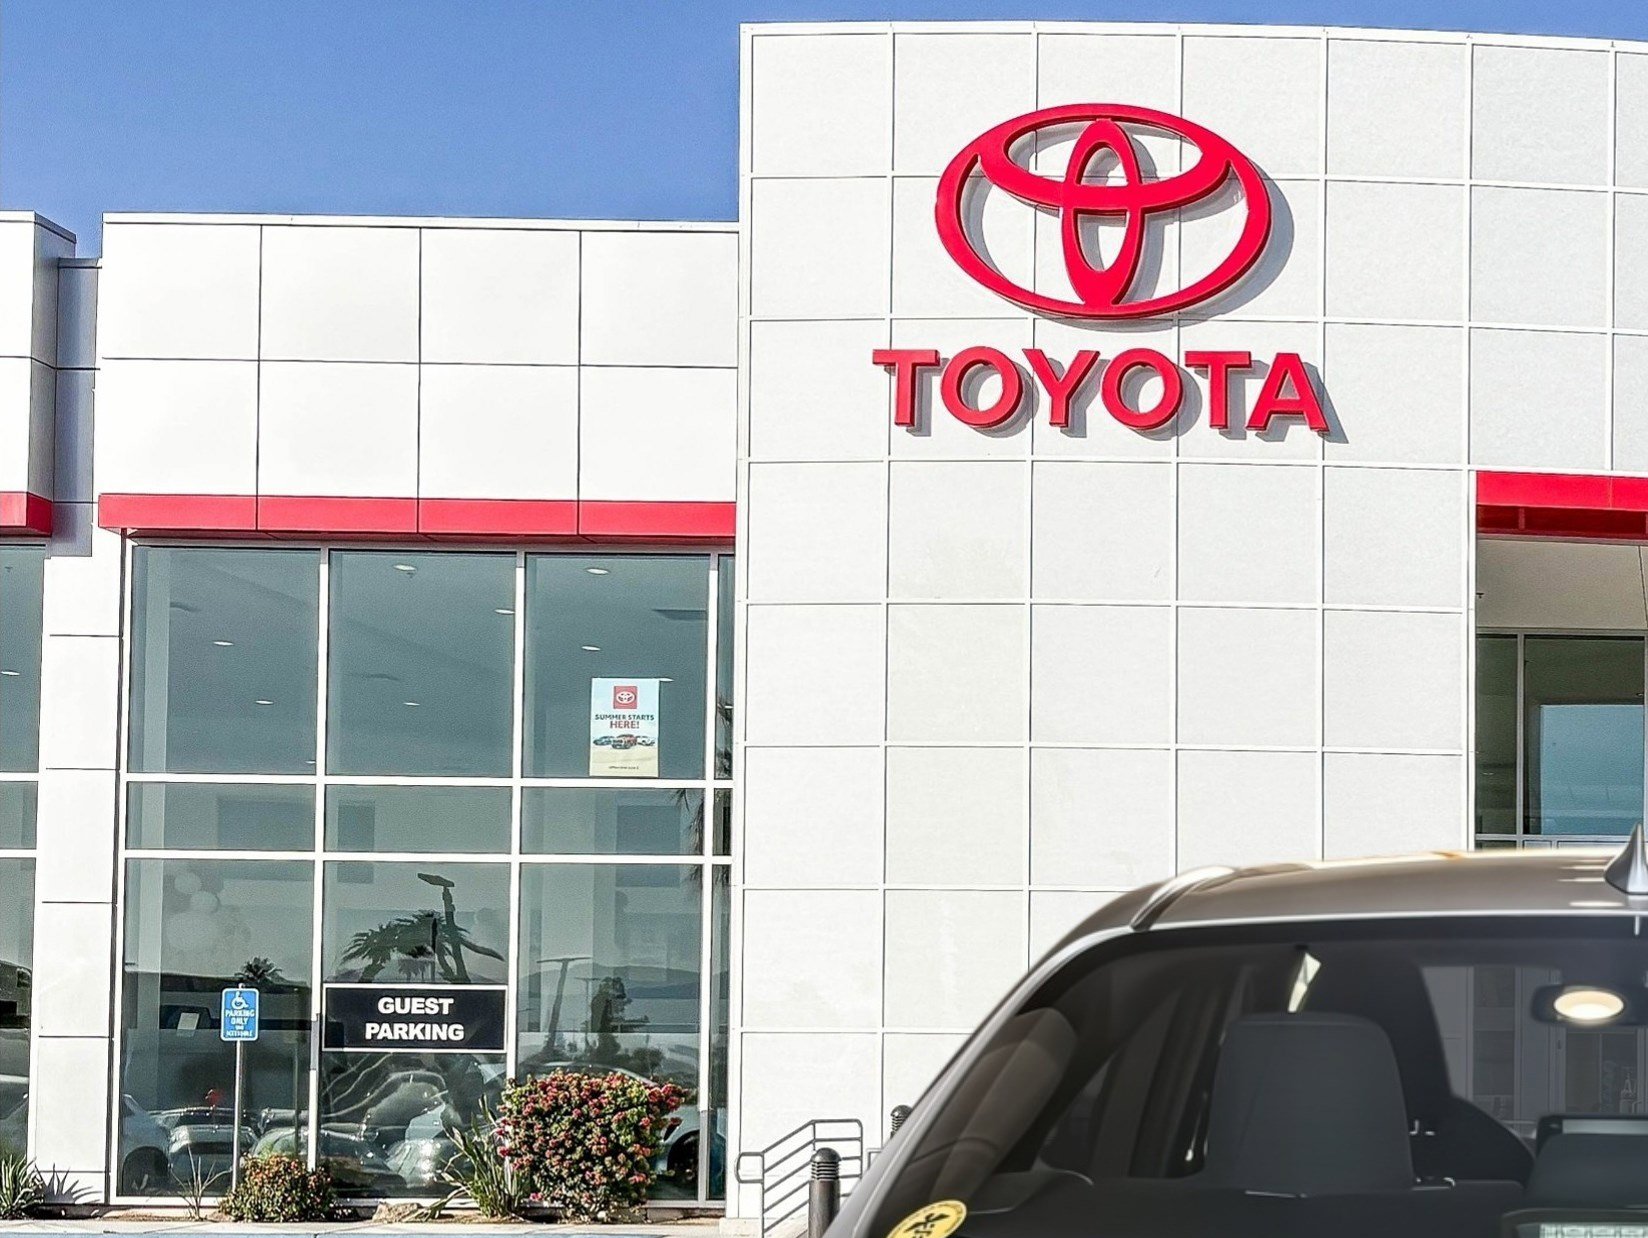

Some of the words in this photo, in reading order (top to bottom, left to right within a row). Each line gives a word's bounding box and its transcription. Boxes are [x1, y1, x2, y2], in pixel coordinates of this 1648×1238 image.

[872, 346, 1329, 432] TOYOTA
[609, 720, 640, 729] HERE!
[377, 997, 454, 1015] GUEST
[230, 1017, 249, 1025] ONLY
[365, 1022, 465, 1041] PARKING
